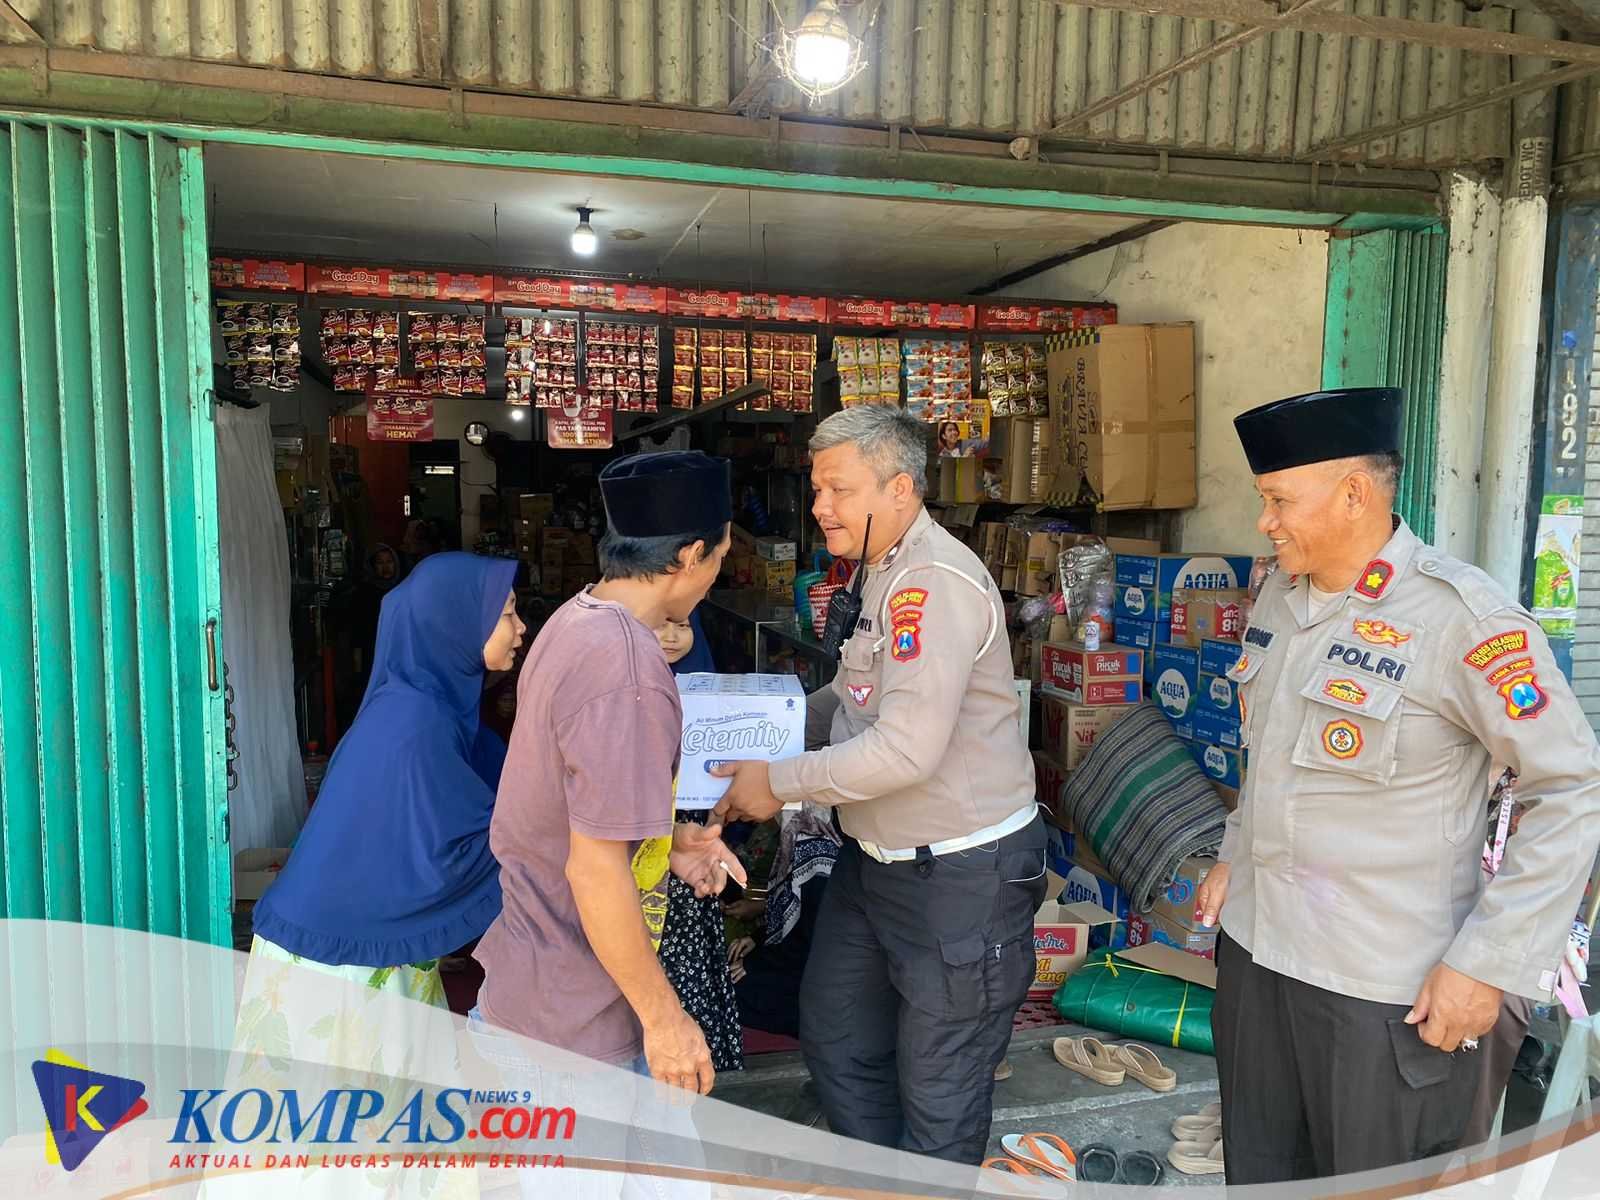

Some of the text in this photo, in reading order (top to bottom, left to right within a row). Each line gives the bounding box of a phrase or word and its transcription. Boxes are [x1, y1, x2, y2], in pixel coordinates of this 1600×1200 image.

[1519, 141, 1535, 200] EDOT WC
[332, 269, 379, 286] Good Day
[517, 280, 562, 295] Good Day
[688, 292, 729, 307] Good Day
[846, 303, 885, 316] Good Day
[1076, 357, 1087, 435] BRAVIA
[386, 430, 417, 439] HEMAT
[1327, 643, 1407, 682] POLRI
[1160, 681, 1185, 700] AQUA
[683, 720, 790, 756] eternity
[1075, 728, 1098, 744] Vit
[1206, 751, 1224, 766] AQUA
[1067, 880, 1098, 904] AQUA
